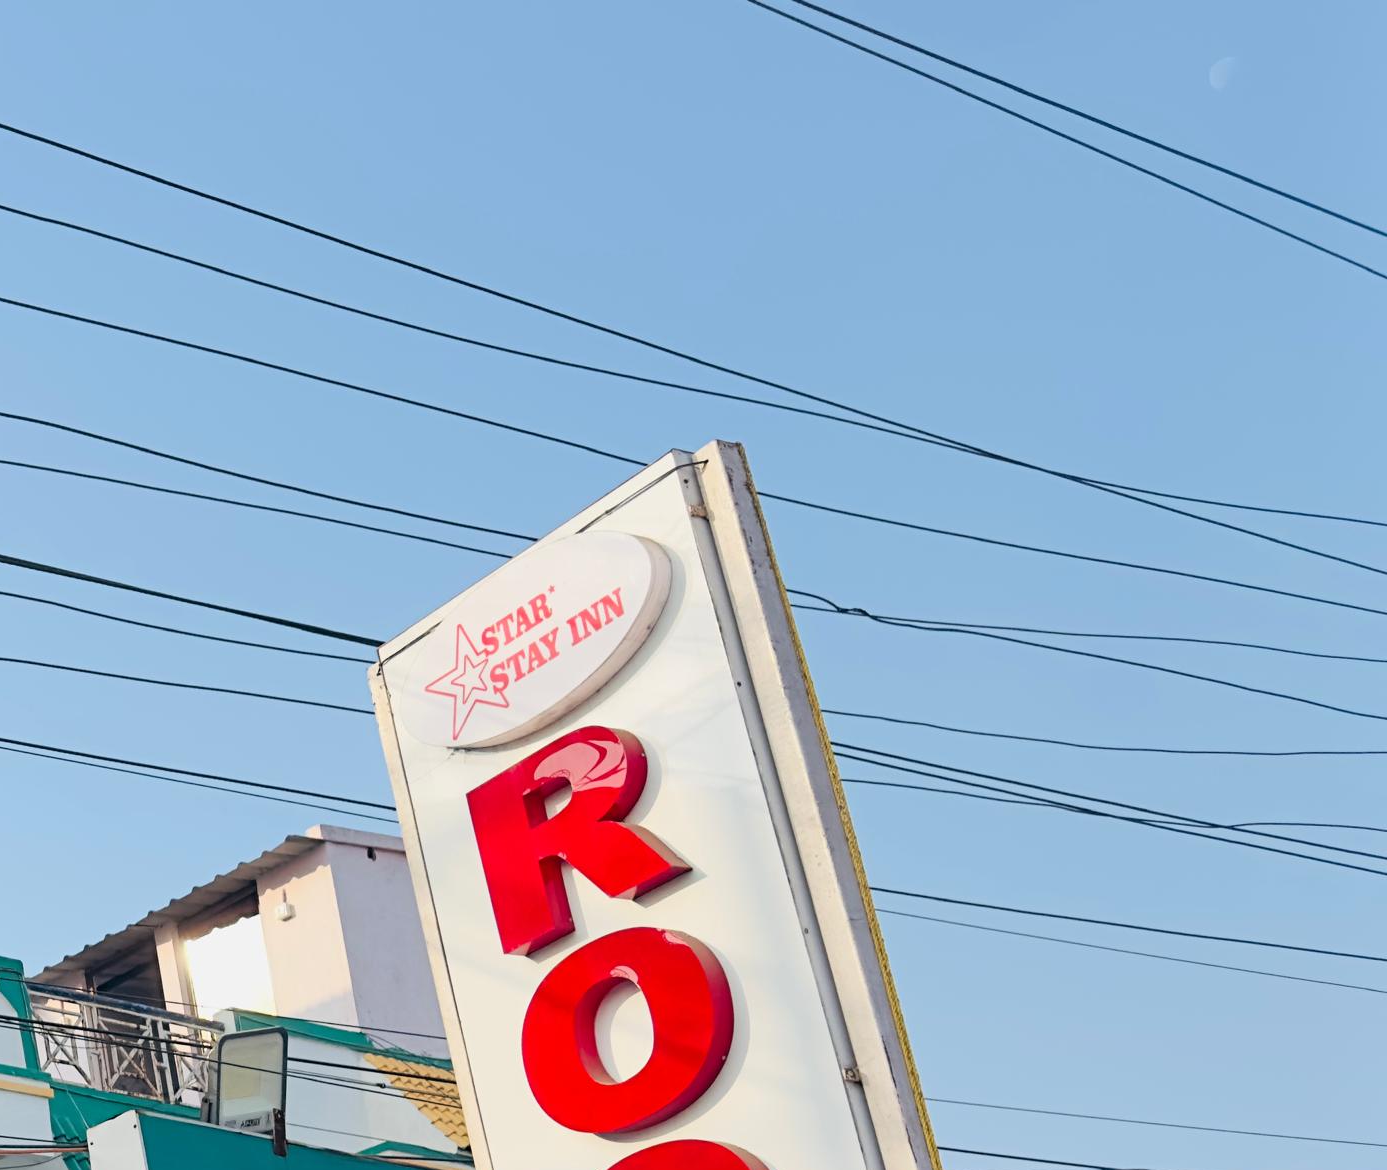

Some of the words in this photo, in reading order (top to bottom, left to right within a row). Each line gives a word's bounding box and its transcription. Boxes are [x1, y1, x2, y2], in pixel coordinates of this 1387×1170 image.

[481, 593, 553, 657] STAR
[489, 627, 560, 695] STAY
[566, 588, 625, 646] INN
